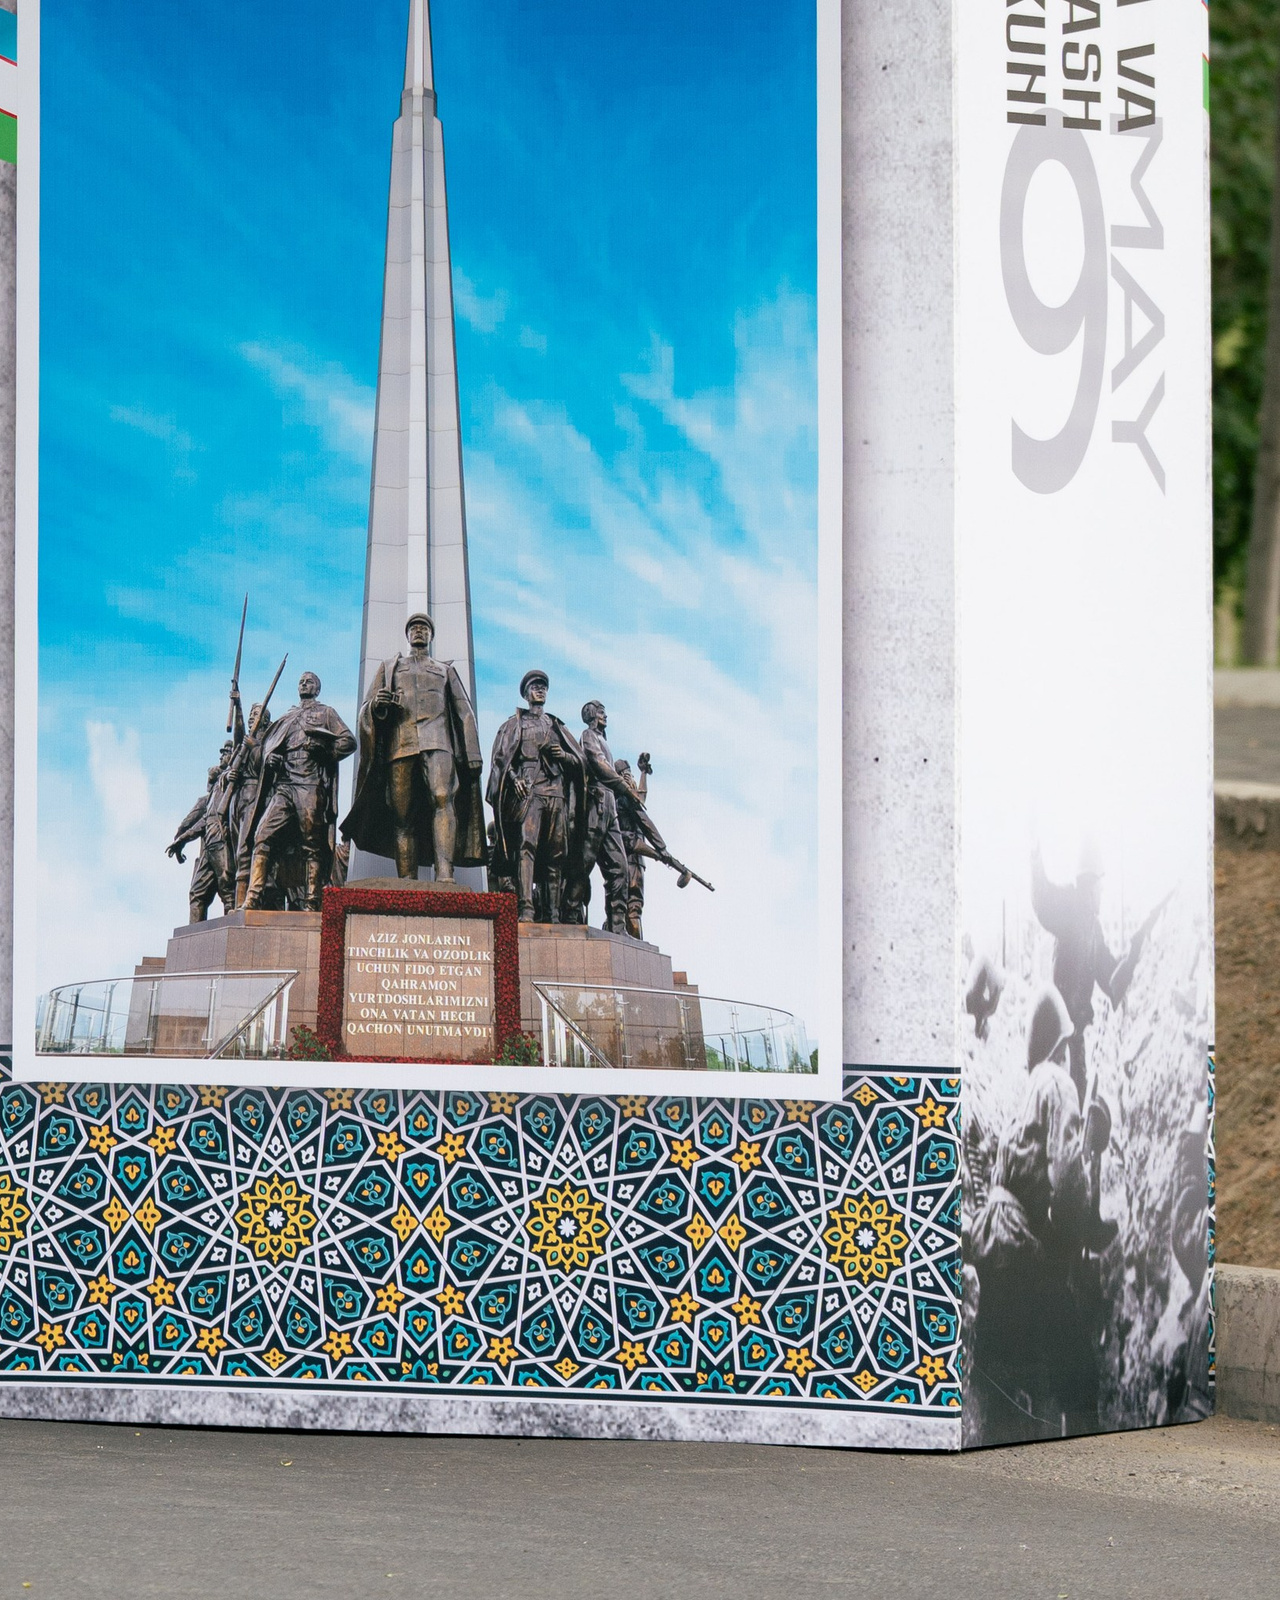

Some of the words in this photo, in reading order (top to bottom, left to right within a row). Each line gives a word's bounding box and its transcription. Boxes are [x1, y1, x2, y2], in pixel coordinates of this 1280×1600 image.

[1116, 43, 1156, 133] VA
[999, 107, 1108, 495] 9
[1109, 113, 1166, 497] MAY
[368, 933, 398, 943] AZIZ
[402, 934, 471, 946] JONLARINI
[348, 946, 409, 959] TINCHLIK
[413, 948, 429, 959] VA
[433, 950, 491, 961] OZODLIK
[356, 963, 400, 974] UCHUN
[405, 964, 435, 975] FIDO
[439, 966, 482, 976] ETGAN
[381, 978, 457, 991] QAHRAMON
[349, 992, 489, 1007] YURTDOSHLARIMIZNI
[360, 1008, 387, 1019] ONA
[393, 1009, 435, 1020] VATAN
[440, 1010, 476, 1022] HECH
[346, 1022, 402, 1035] QACHON
